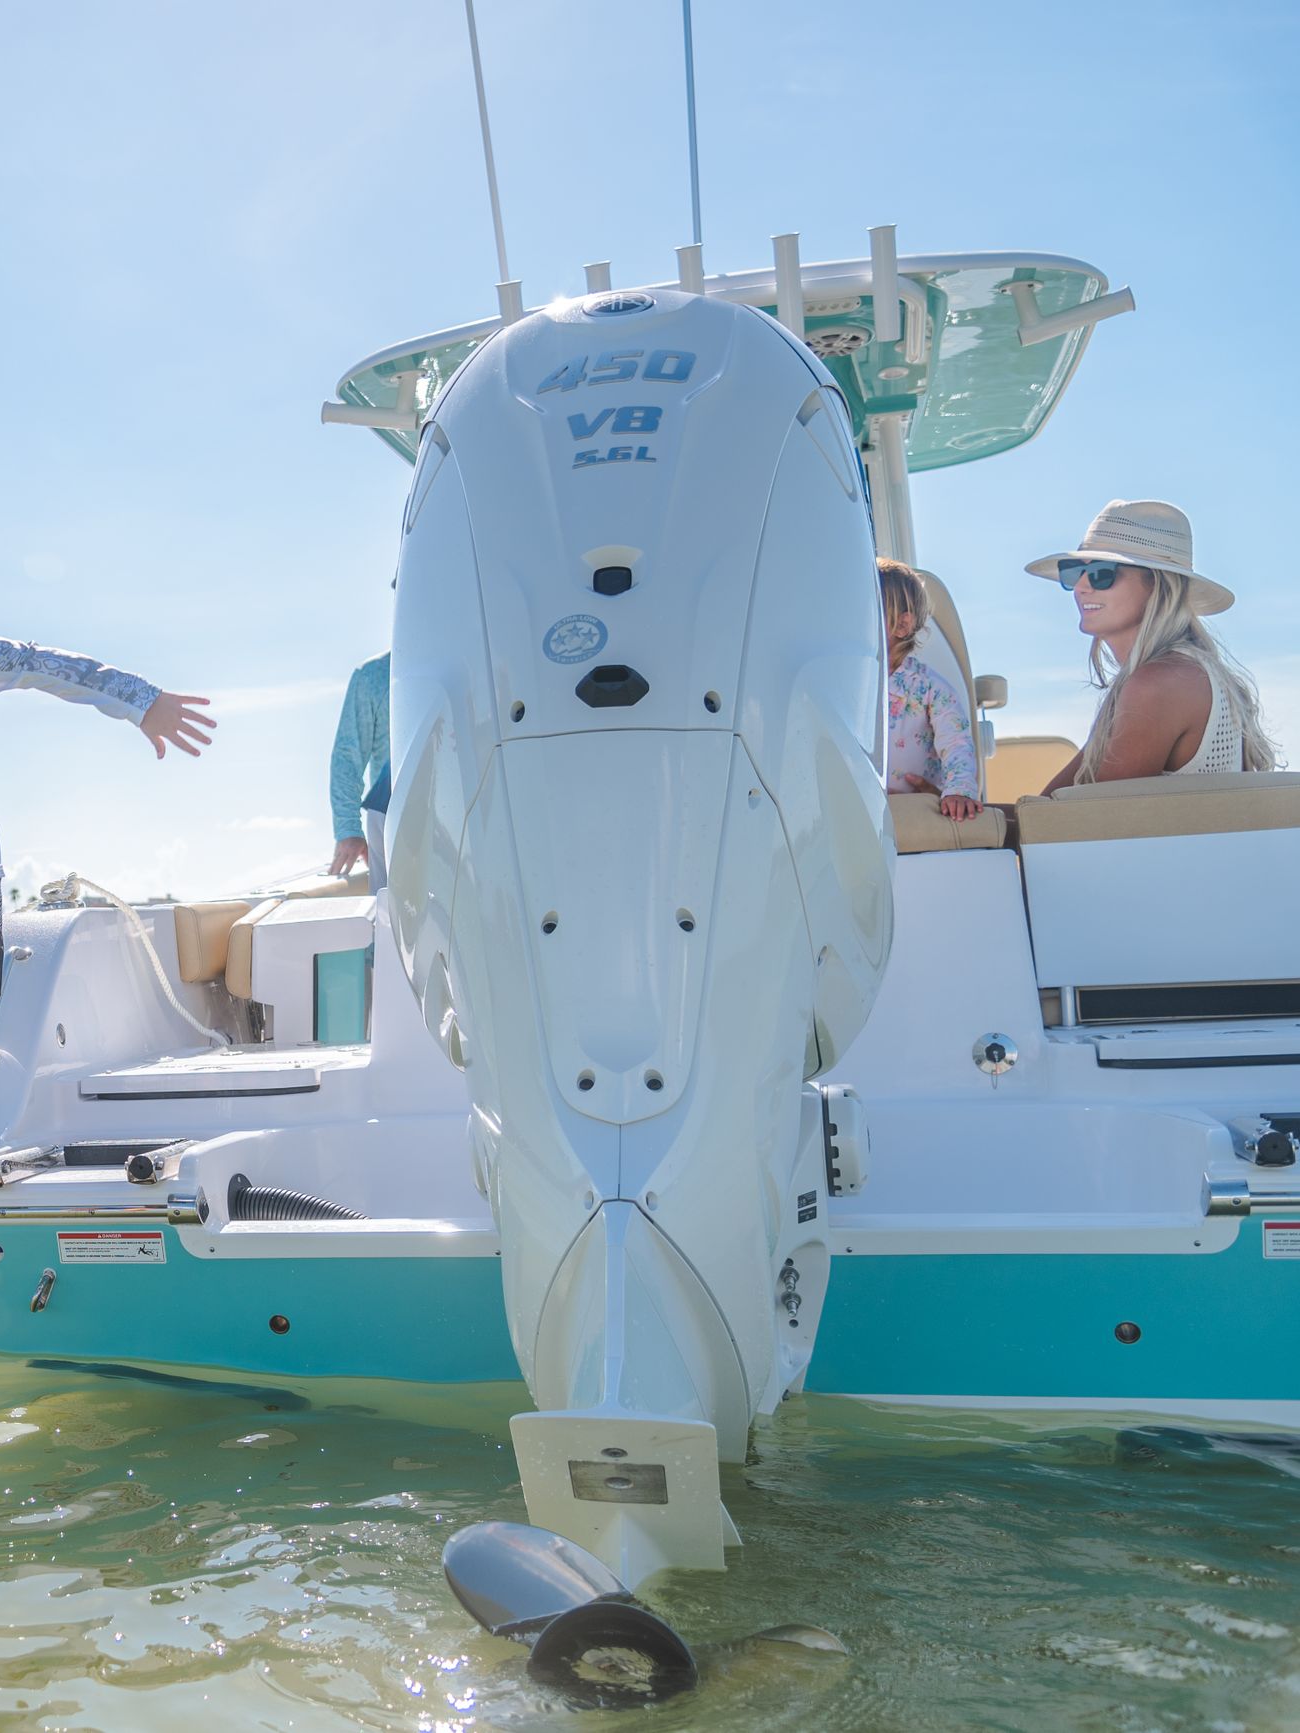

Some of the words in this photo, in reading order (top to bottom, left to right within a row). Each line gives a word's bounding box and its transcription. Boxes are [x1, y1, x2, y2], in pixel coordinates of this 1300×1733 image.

[536, 350, 697, 395] 450
[567, 406, 663, 441] V8
[572, 446, 657, 470] 5.6L
